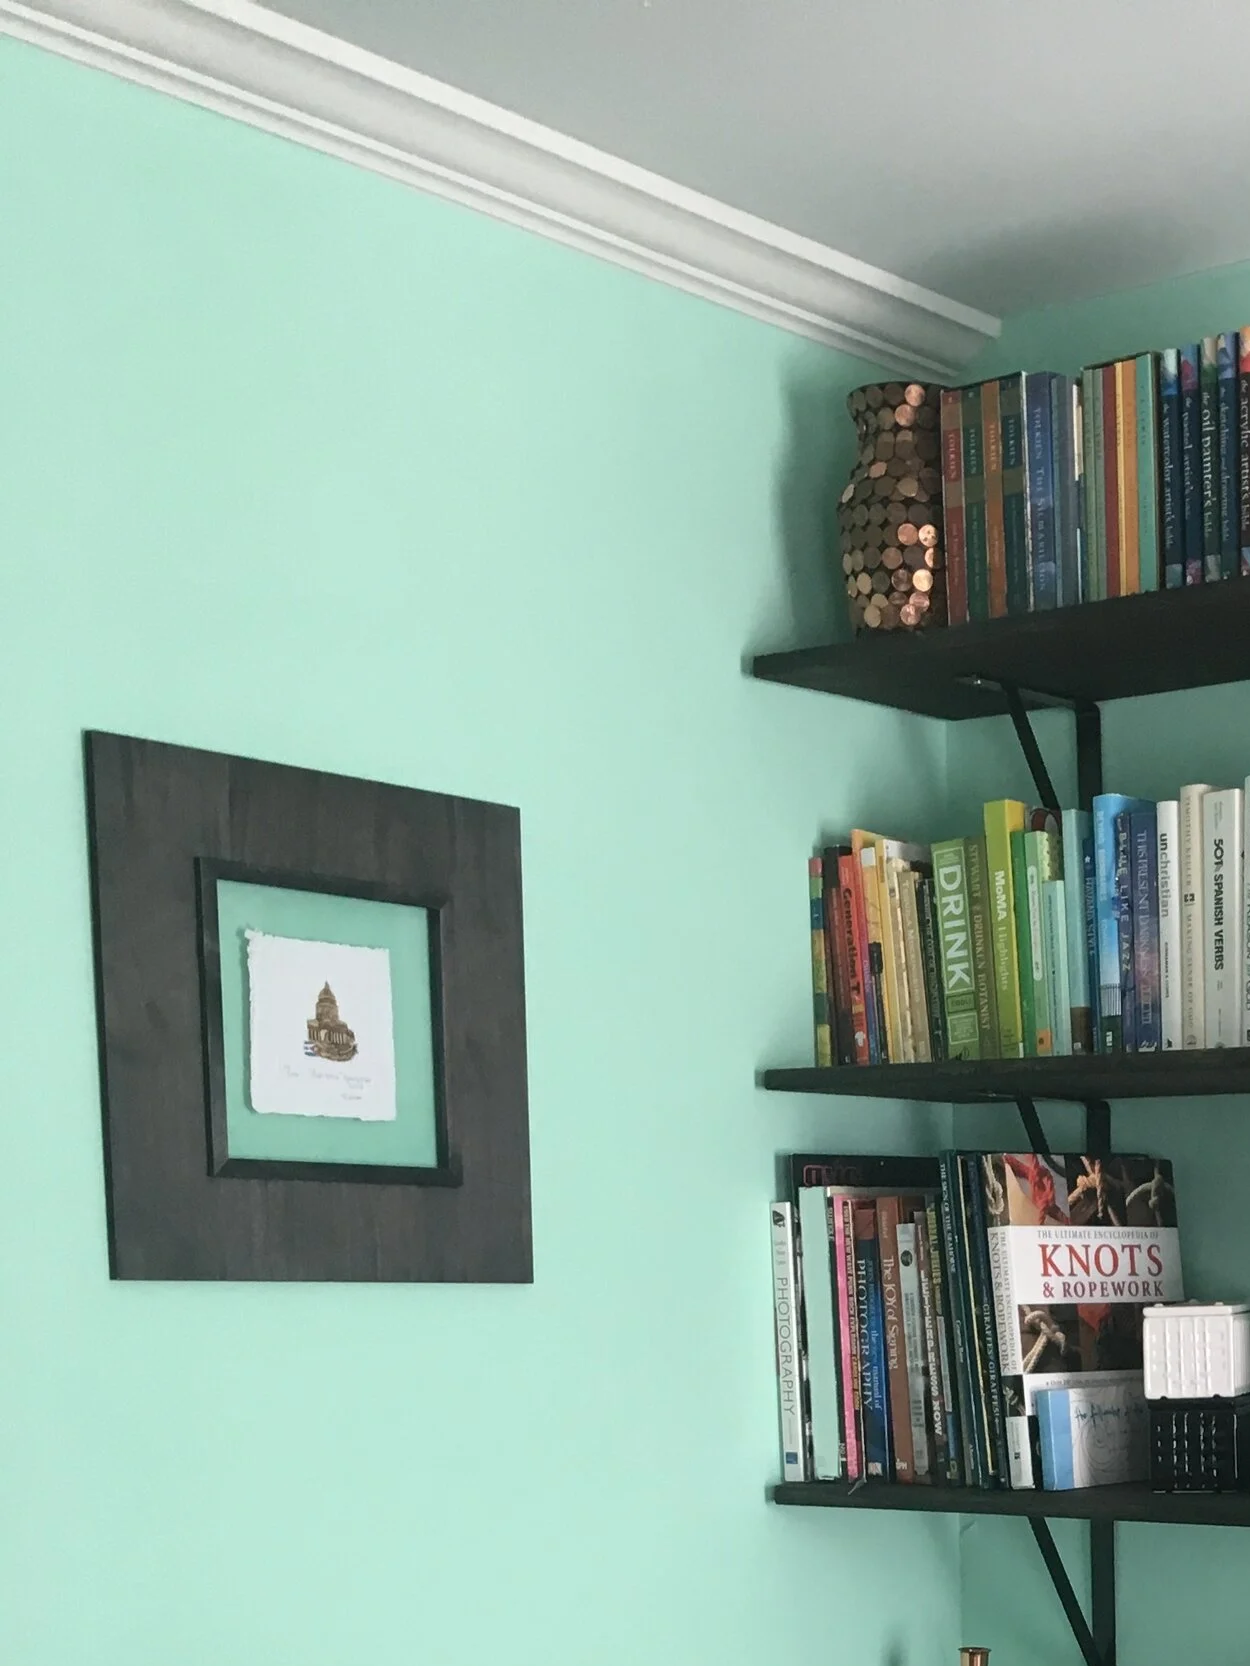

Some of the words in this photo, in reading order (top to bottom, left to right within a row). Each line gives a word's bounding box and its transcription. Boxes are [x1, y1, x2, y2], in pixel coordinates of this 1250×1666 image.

[1007, 418, 1017, 466] TOLKIEN
[1033, 408, 1044, 460] TOLKIEN
[1182, 411, 1193, 450] pastel
[1201, 408, 1217, 432] oil
[947, 432, 958, 479] TOLKIEN
[968, 427, 978, 475] TOLKIEN
[988, 422, 999, 473] TOLKIEN
[1163, 416, 1175, 484] watercolor
[1200, 435, 1217, 509] painter's
[1117, 831, 1129, 878] BLUE
[1157, 832, 1172, 918] unchristian
[994, 869, 1009, 921] MoMA
[1119, 884, 1130, 923] LIKE
[1213, 872, 1225, 927] SPANISH
[842, 887, 858, 979] Generation
[939, 864, 974, 992] DRINK
[1213, 928, 1225, 972] VERBS
[995, 923, 1011, 992] Highlights
[1121, 932, 1131, 972] JAZZ
[976, 973, 991, 1030] BOTANIST
[939, 1163, 947, 1179] THE
[941, 1181, 949, 1200] SIGN
[944, 1214, 952, 1231] THE
[1037, 1229, 1052, 1240] THE
[1053, 1229, 1092, 1240] ULTIMATE
[1093, 1229, 1149, 1240] ENCYCLOPEDIA
[882, 1255, 895, 1282] The
[946, 1232, 956, 1274] SEAHORSE
[989, 1231, 1002, 1280] KNOTS
[1001, 1250, 1011, 1293] ULTIMATE
[1038, 1242, 1164, 1279] KNOTS
[882, 1282, 898, 1308] JOY
[1042, 1280, 1055, 1299] &
[1062, 1279, 1165, 1299] ROPEWORK
[856, 1259, 873, 1411] PHOTOGRAPHY
[869, 1329, 880, 1345] the
[886, 1309, 899, 1321] of
[993, 1293, 1010, 1373] ROPEWORK
[1005, 1296, 1016, 1358] ENCYCLOPEDIA
[776, 1275, 796, 1416] PHOTOGRAPHY
[884, 1324, 901, 1370] Signing
[920, 1269, 940, 1396] LETTERPRESS
[932, 1399, 943, 1436] NOW
[872, 1365, 882, 1398] manual
